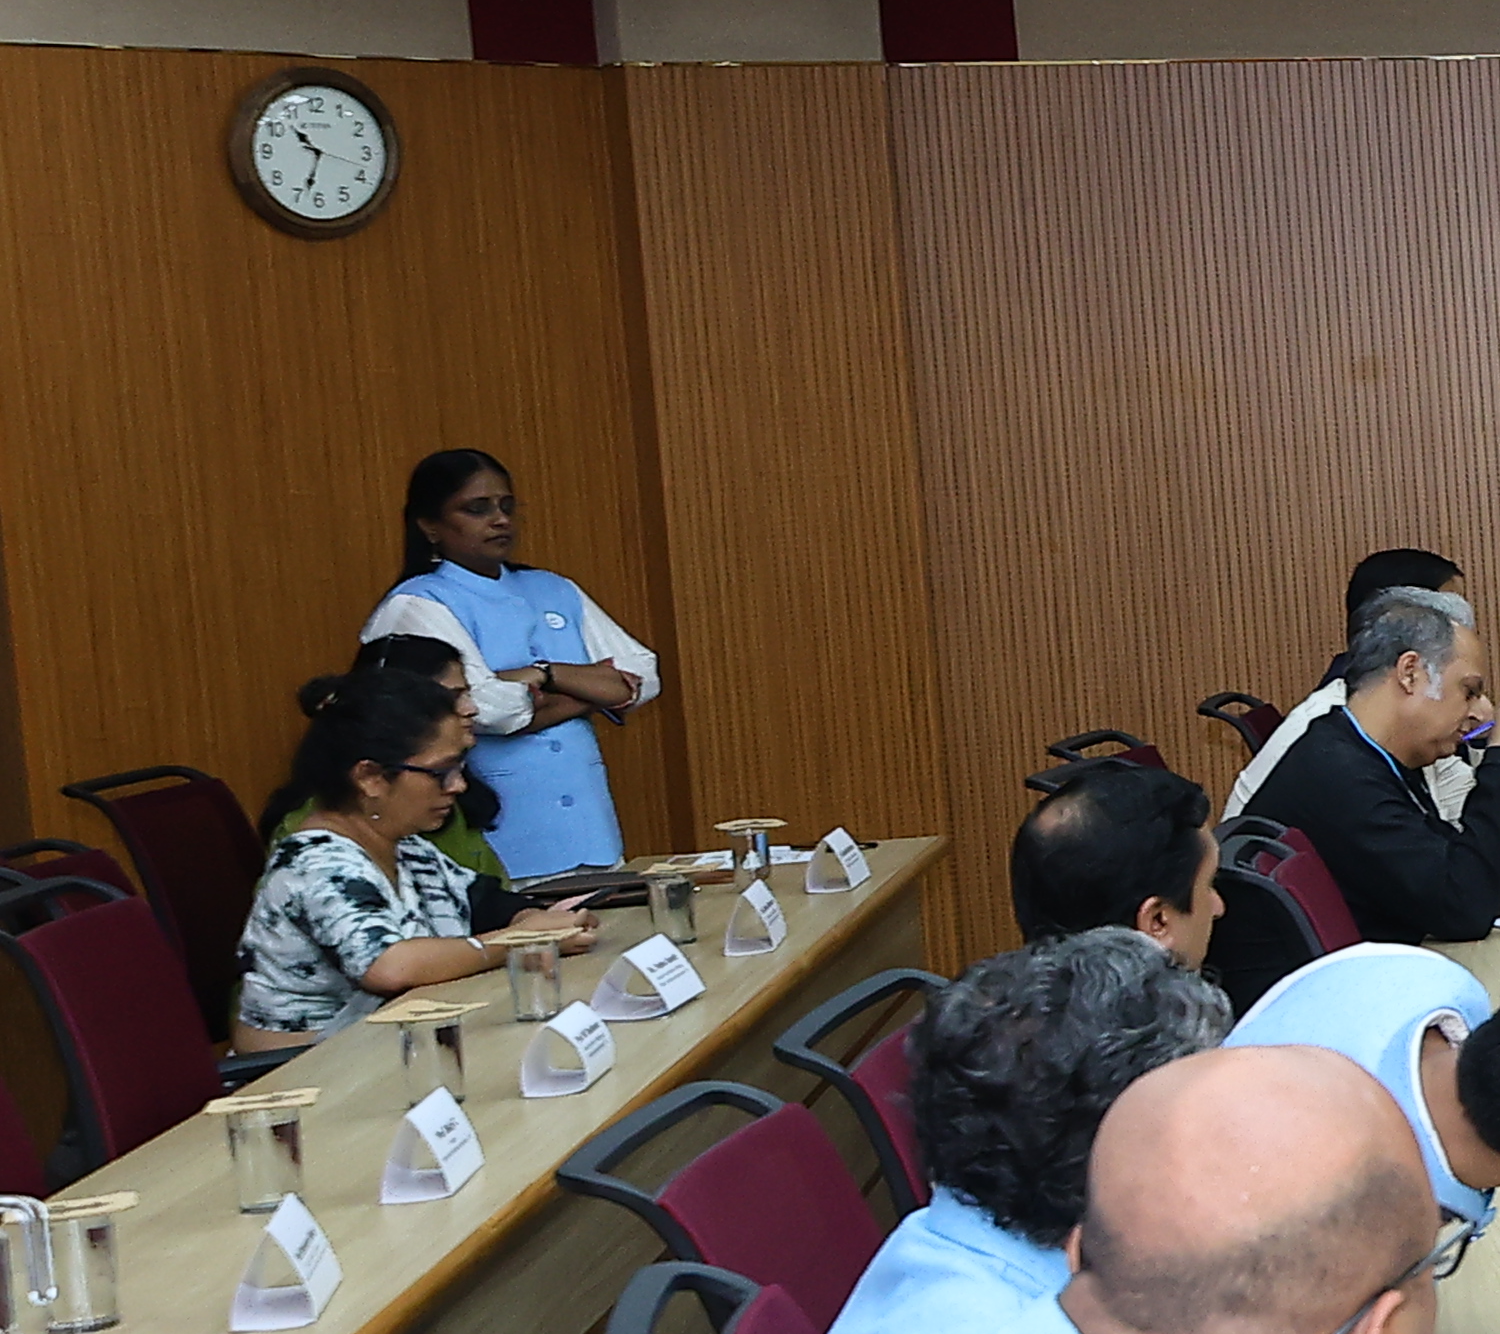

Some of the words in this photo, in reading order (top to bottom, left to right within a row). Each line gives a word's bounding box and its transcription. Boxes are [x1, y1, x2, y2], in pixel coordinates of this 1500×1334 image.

[309, 97, 325, 113] 12
[354, 121, 364, 137] 2
[261, 143, 273, 159] 9
[361, 146, 372, 162] 3
[271, 170, 284, 186] 8
[354, 170, 366, 183] 4
[292, 188, 304, 203] 7
[313, 193, 325, 208] 6
[338, 186, 350, 203] 5
